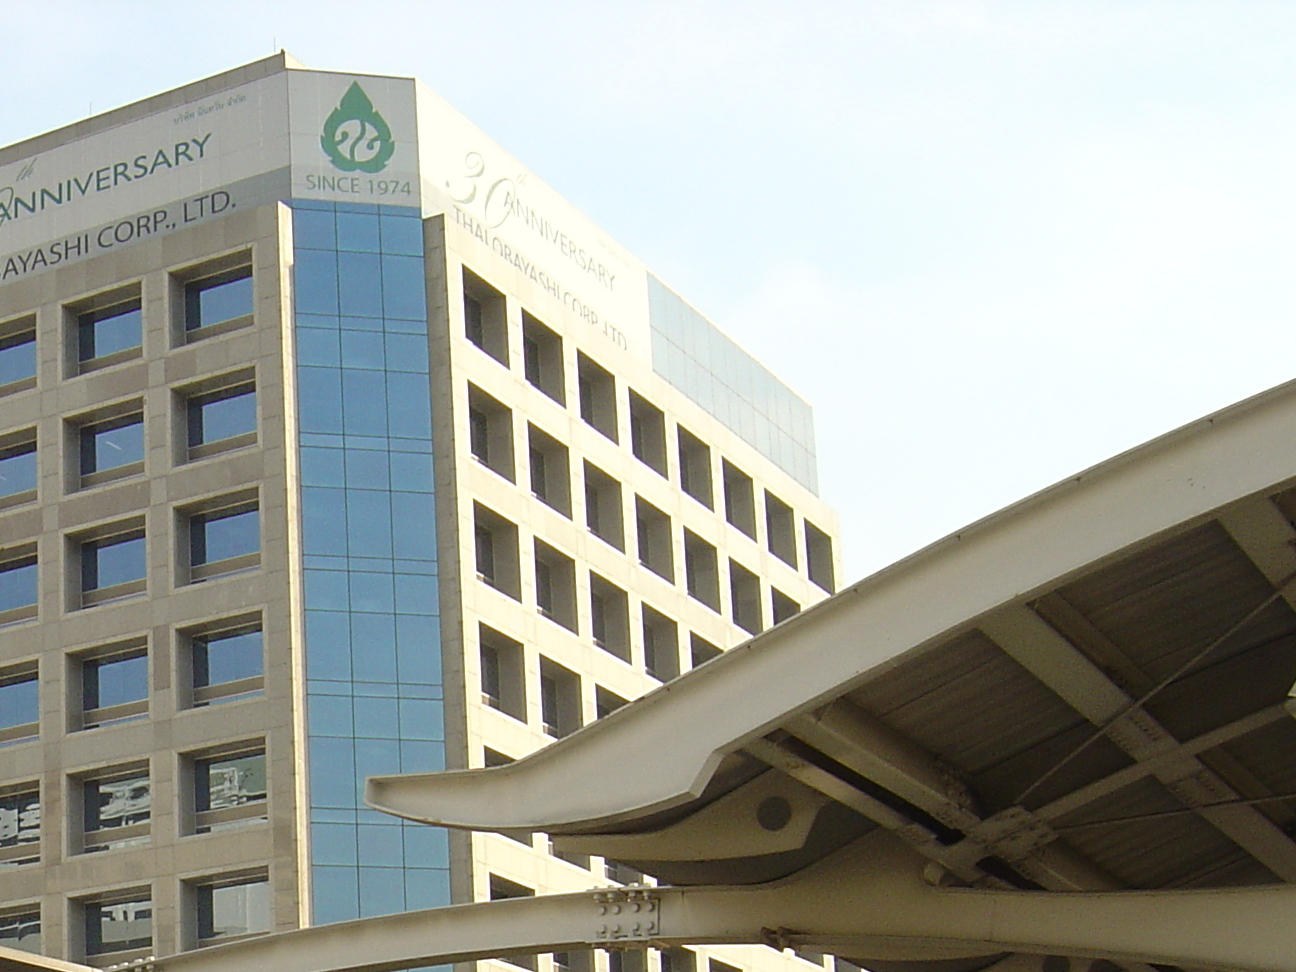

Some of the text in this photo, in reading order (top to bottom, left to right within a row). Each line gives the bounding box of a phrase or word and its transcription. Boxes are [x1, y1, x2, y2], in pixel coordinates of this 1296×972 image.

[306, 174, 412, 195] SINCE 1974
[97, 210, 176, 248] CORP.,
[184, 191, 236, 223] LTD.
[446, 152, 516, 228] 30
[504, 190, 616, 292] ANNIVERSARY
[453, 205, 489, 246] THAI
